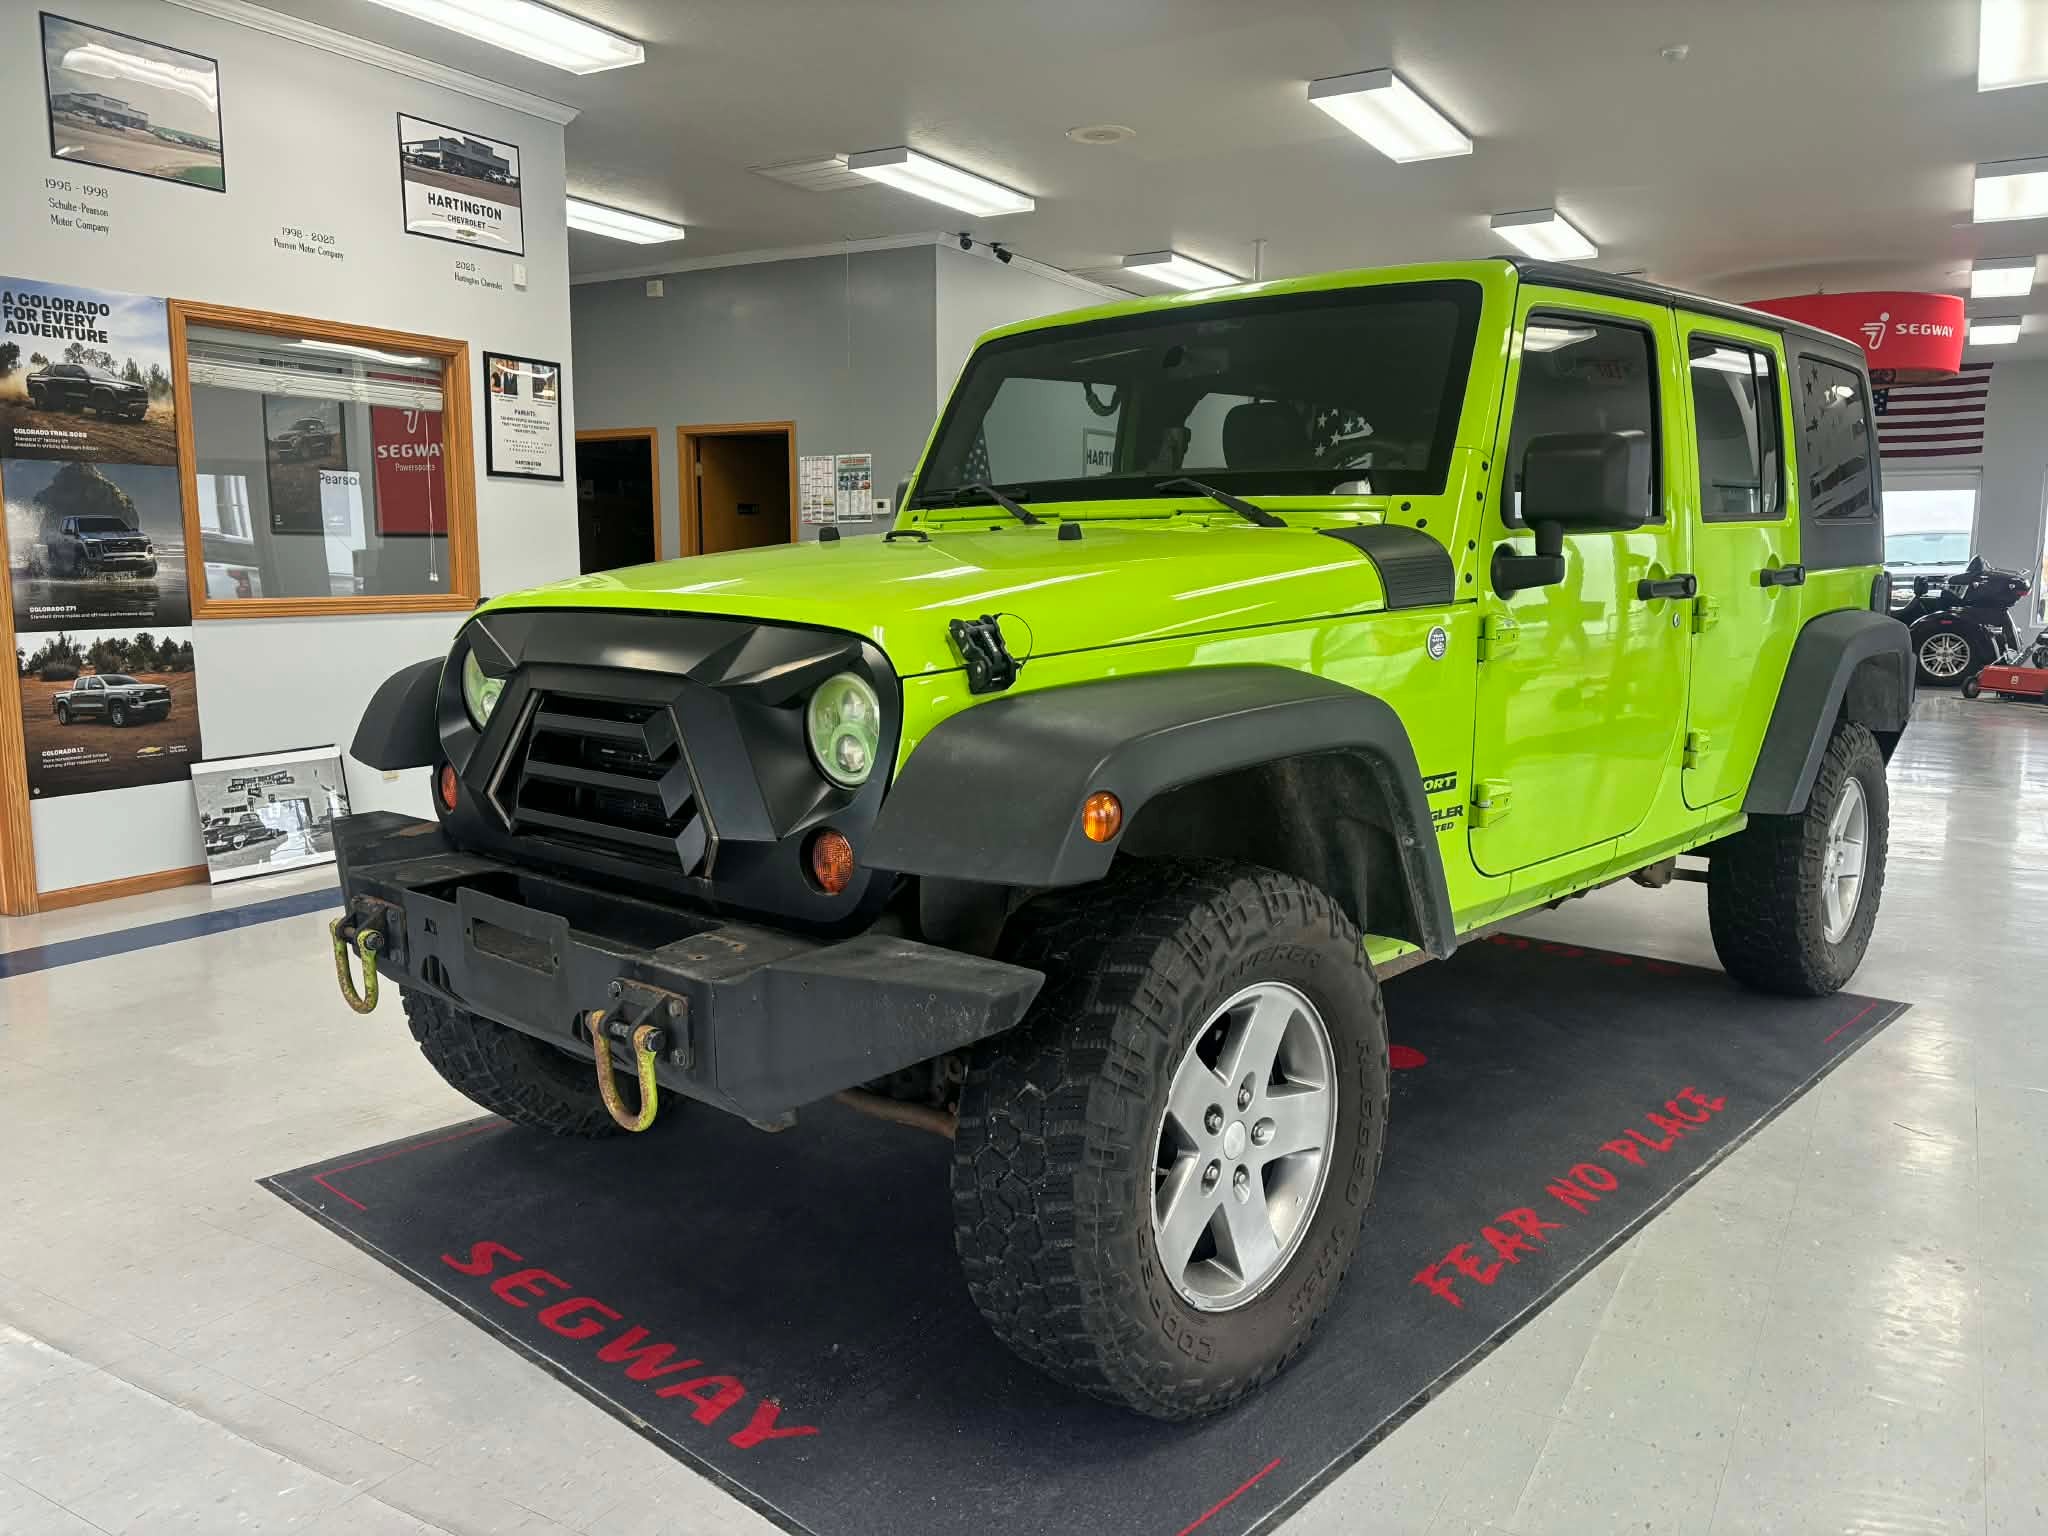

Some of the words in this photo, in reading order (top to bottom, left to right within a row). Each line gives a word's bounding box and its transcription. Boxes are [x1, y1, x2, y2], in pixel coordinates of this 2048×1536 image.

[82, 184, 108, 199] 1998
[428, 192, 502, 221] HARTINGTON
[50, 214, 72, 227] Motor
[75, 218, 109, 235] Company
[447, 214, 486, 229] CHEVROLET
[282, 226, 303, 239] 1998
[317, 246, 344, 261] Company
[2, 291, 15, 305] A
[17, 292, 110, 317] COLORADO
[3, 305, 38, 322] FOR
[41, 309, 97, 329] EVERY
[5, 319, 109, 344] ADVENTURE
[1895, 323, 1954, 338] SEGWAY
[13, 428, 49, 436] COLORADO
[395, 462, 436, 472] Powersports
[42, 748, 76, 757] COLORADO
[1423, 775, 1456, 791] ORT
[1431, 805, 1463, 821] GLER
[1435, 822, 1454, 832] TED
[1409, 1206, 1566, 1310] FEAR
[1545, 1163, 1619, 1216] NO
[1599, 1086, 1728, 1167] PLACE
[440, 1240, 820, 1450] SEGWAY
